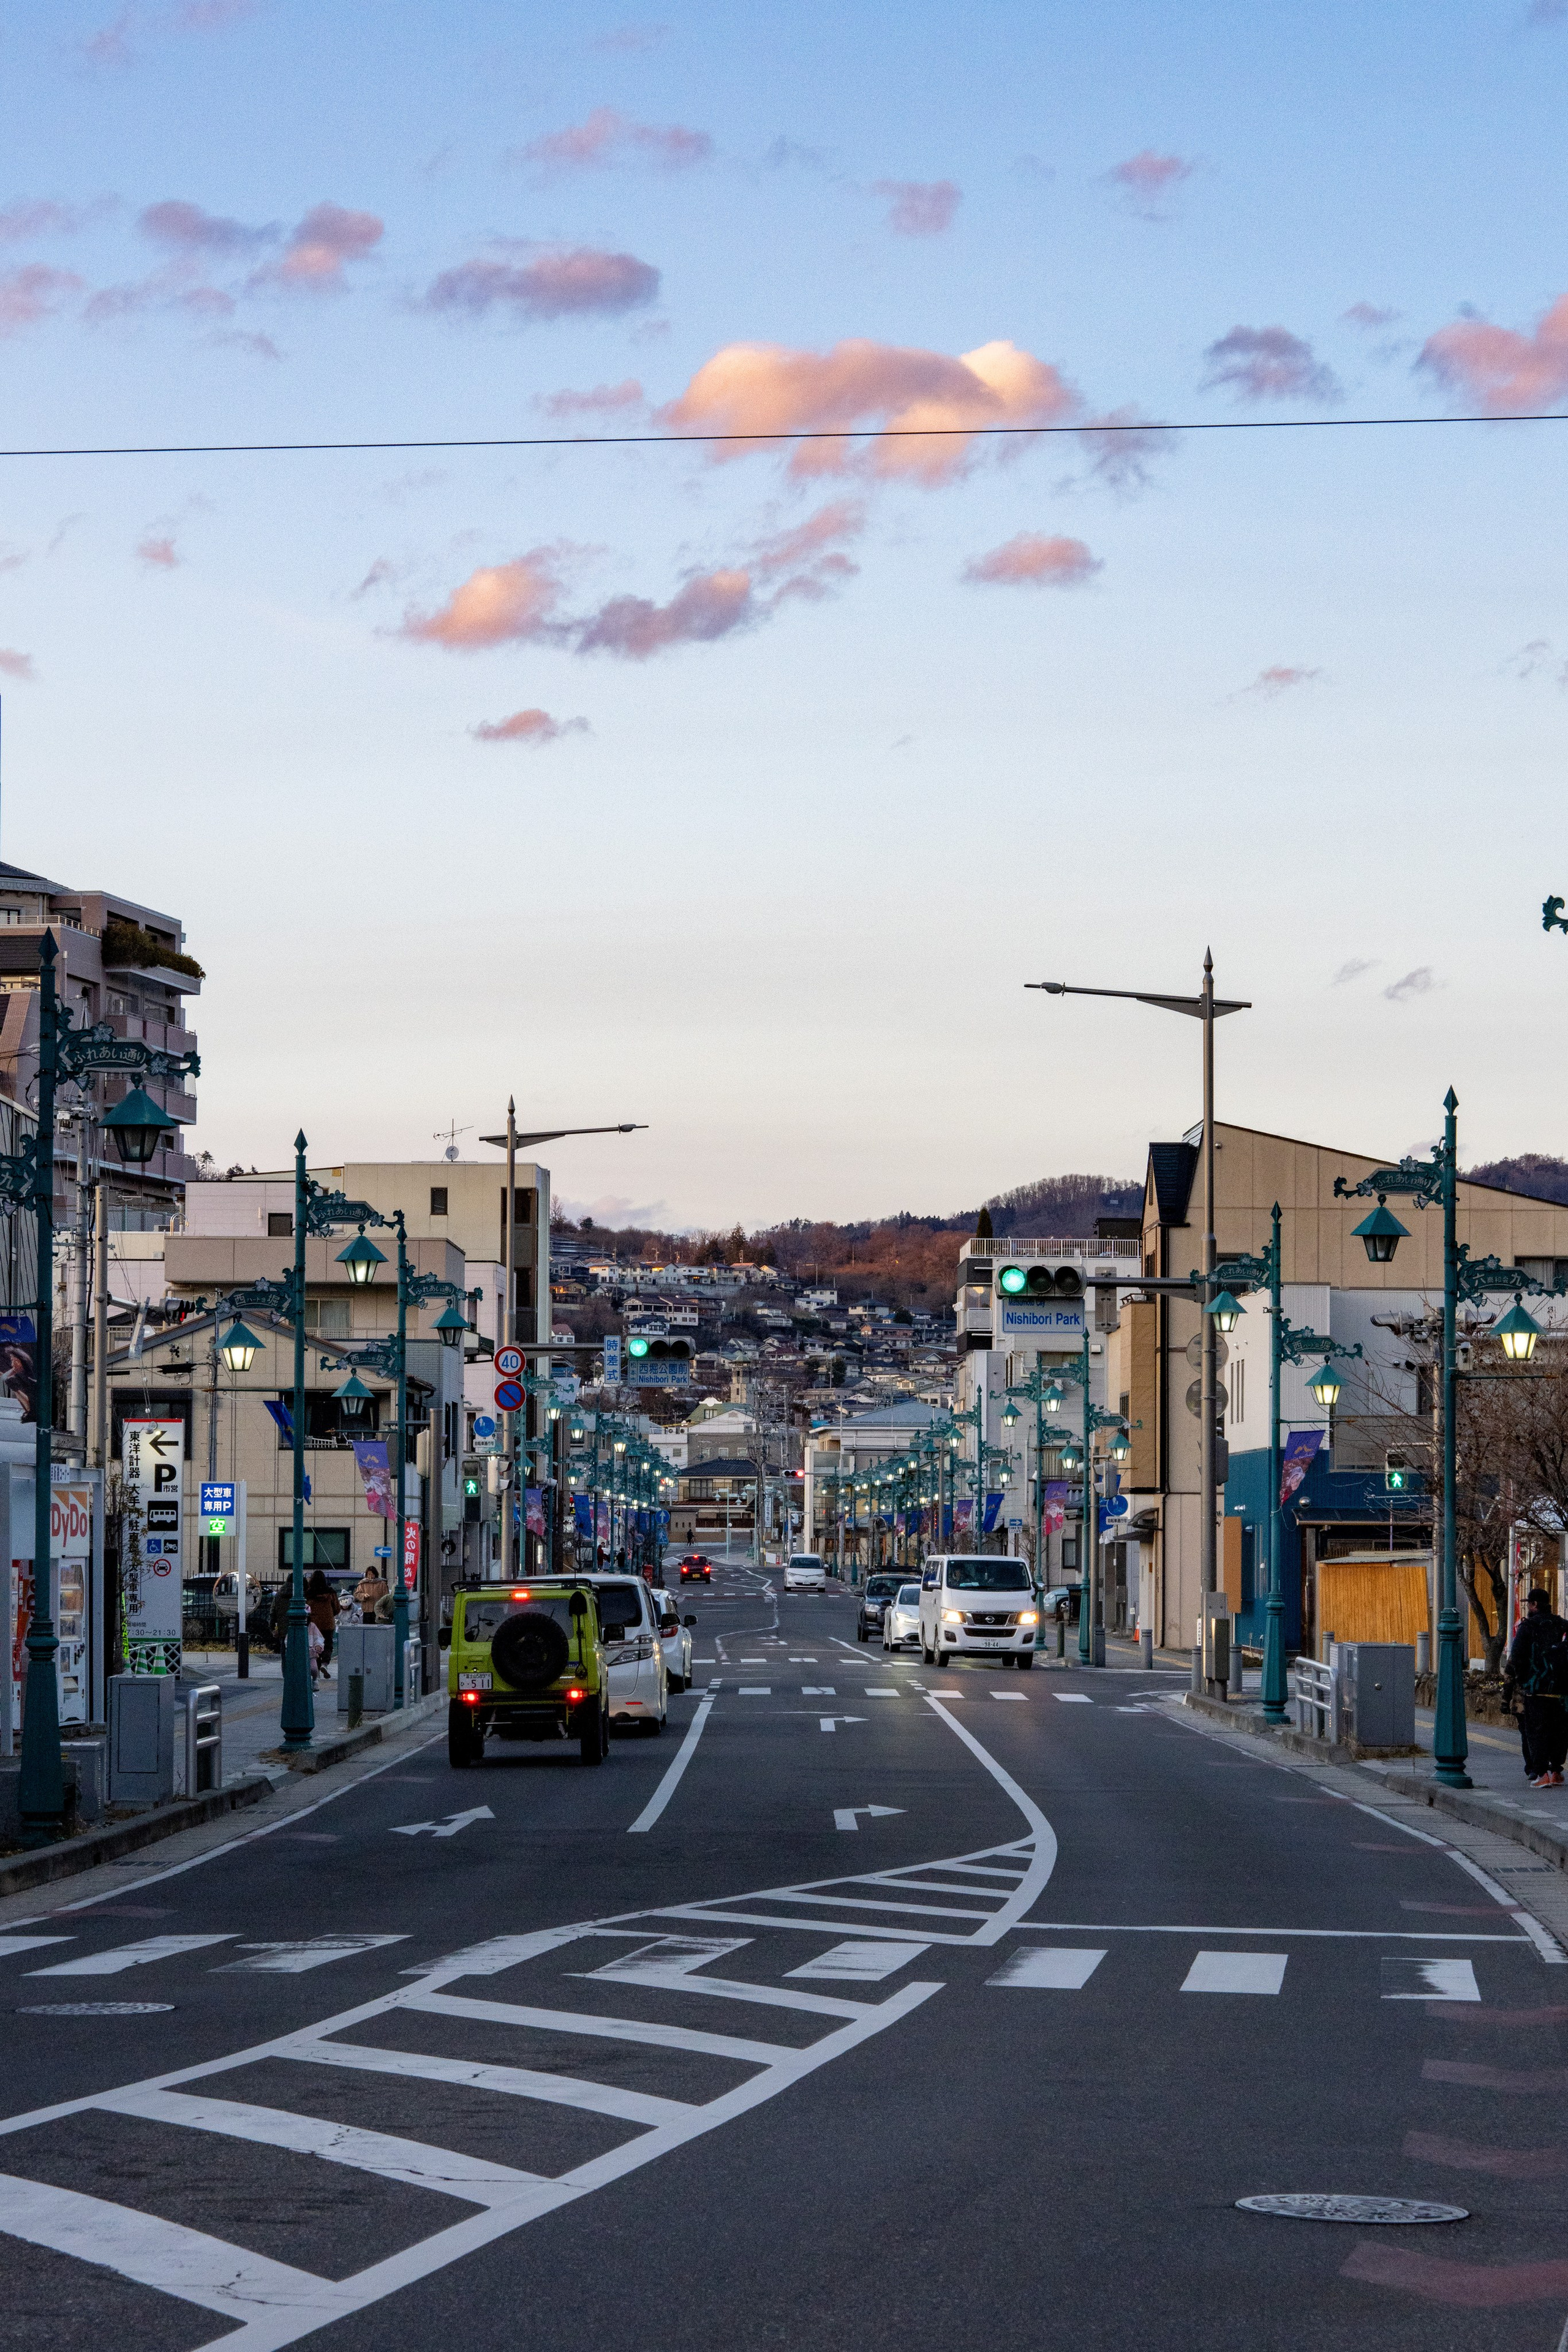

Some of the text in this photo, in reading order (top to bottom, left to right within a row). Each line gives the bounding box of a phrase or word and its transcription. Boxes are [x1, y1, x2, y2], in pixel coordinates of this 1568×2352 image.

[74, 1046, 146, 1065] ふれあい通り
[1376, 1174, 1431, 1188] ふれあい通り
[318, 1207, 368, 1218] ふれあい通り
[1221, 1267, 1262, 1278] ふれあい通り
[1006, 1312, 1080, 1324] Nishibori Park
[502, 1355, 518, 1368] 40
[606, 1340, 618, 1381] 時差式
[639, 1363, 687, 1374] 西堀公園前
[129, 1431, 141, 1479] 東洋計器
[154, 1464, 177, 1492] P
[204, 1487, 232, 1498] 大型車
[203, 1501, 232, 1512] 専用P
[51, 1503, 88, 1548] DyDo
[209, 1518, 225, 1534] 空
[404, 1527, 417, 1578] 火の用心
[129, 1560, 139, 1613] 大型車専用
